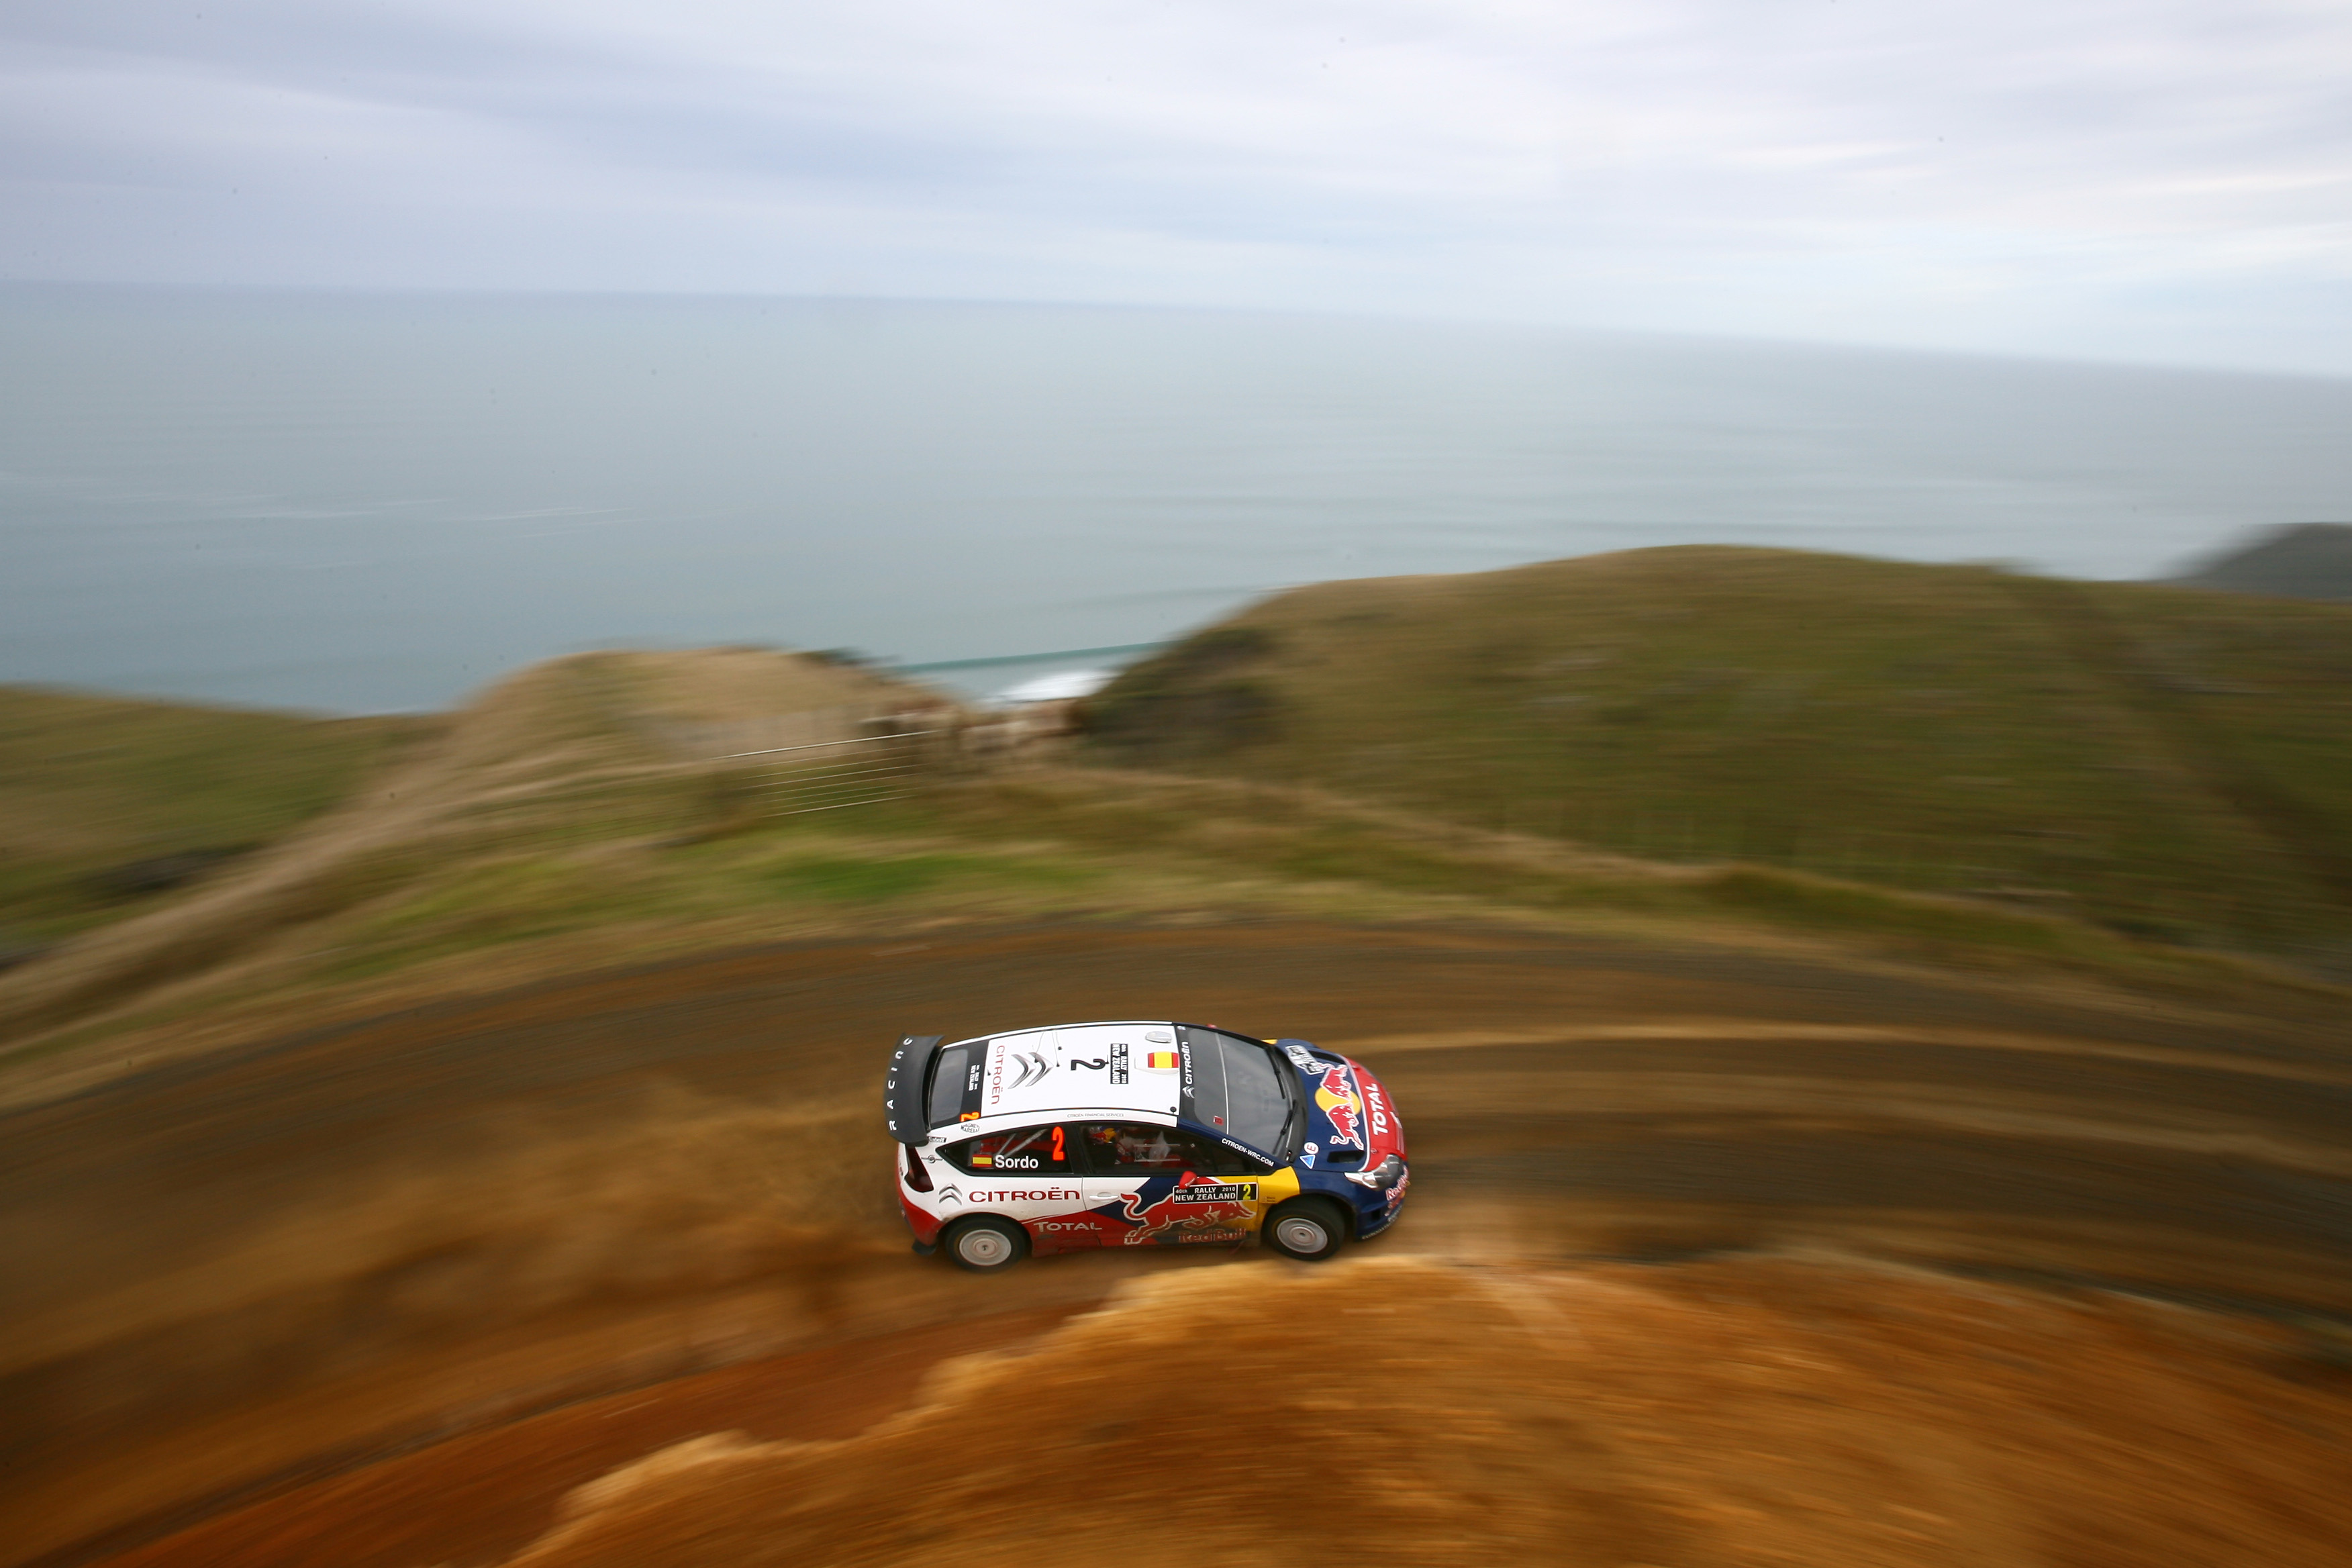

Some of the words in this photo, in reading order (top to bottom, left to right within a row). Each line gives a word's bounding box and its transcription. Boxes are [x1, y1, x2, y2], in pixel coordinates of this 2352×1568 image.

[1112, 1044, 1120, 1056] NEW
[1071, 1059, 1106, 1071] 2
[1112, 1057, 1120, 1084] ZEALAND
[991, 1045, 1006, 1105] CITROËN
[1366, 1083, 1388, 1135] TOTAL
[961, 1112, 979, 1122] 2
[1052, 1126, 1065, 1161] 2
[1222, 1138, 1274, 1167] CITROEN-WRC.COM
[995, 1155, 1038, 1169] Sordo
[969, 1187, 1080, 1202] CITROËN
[1242, 1184, 1251, 1199] 2
[1034, 1222, 1102, 1232] TOTAL
